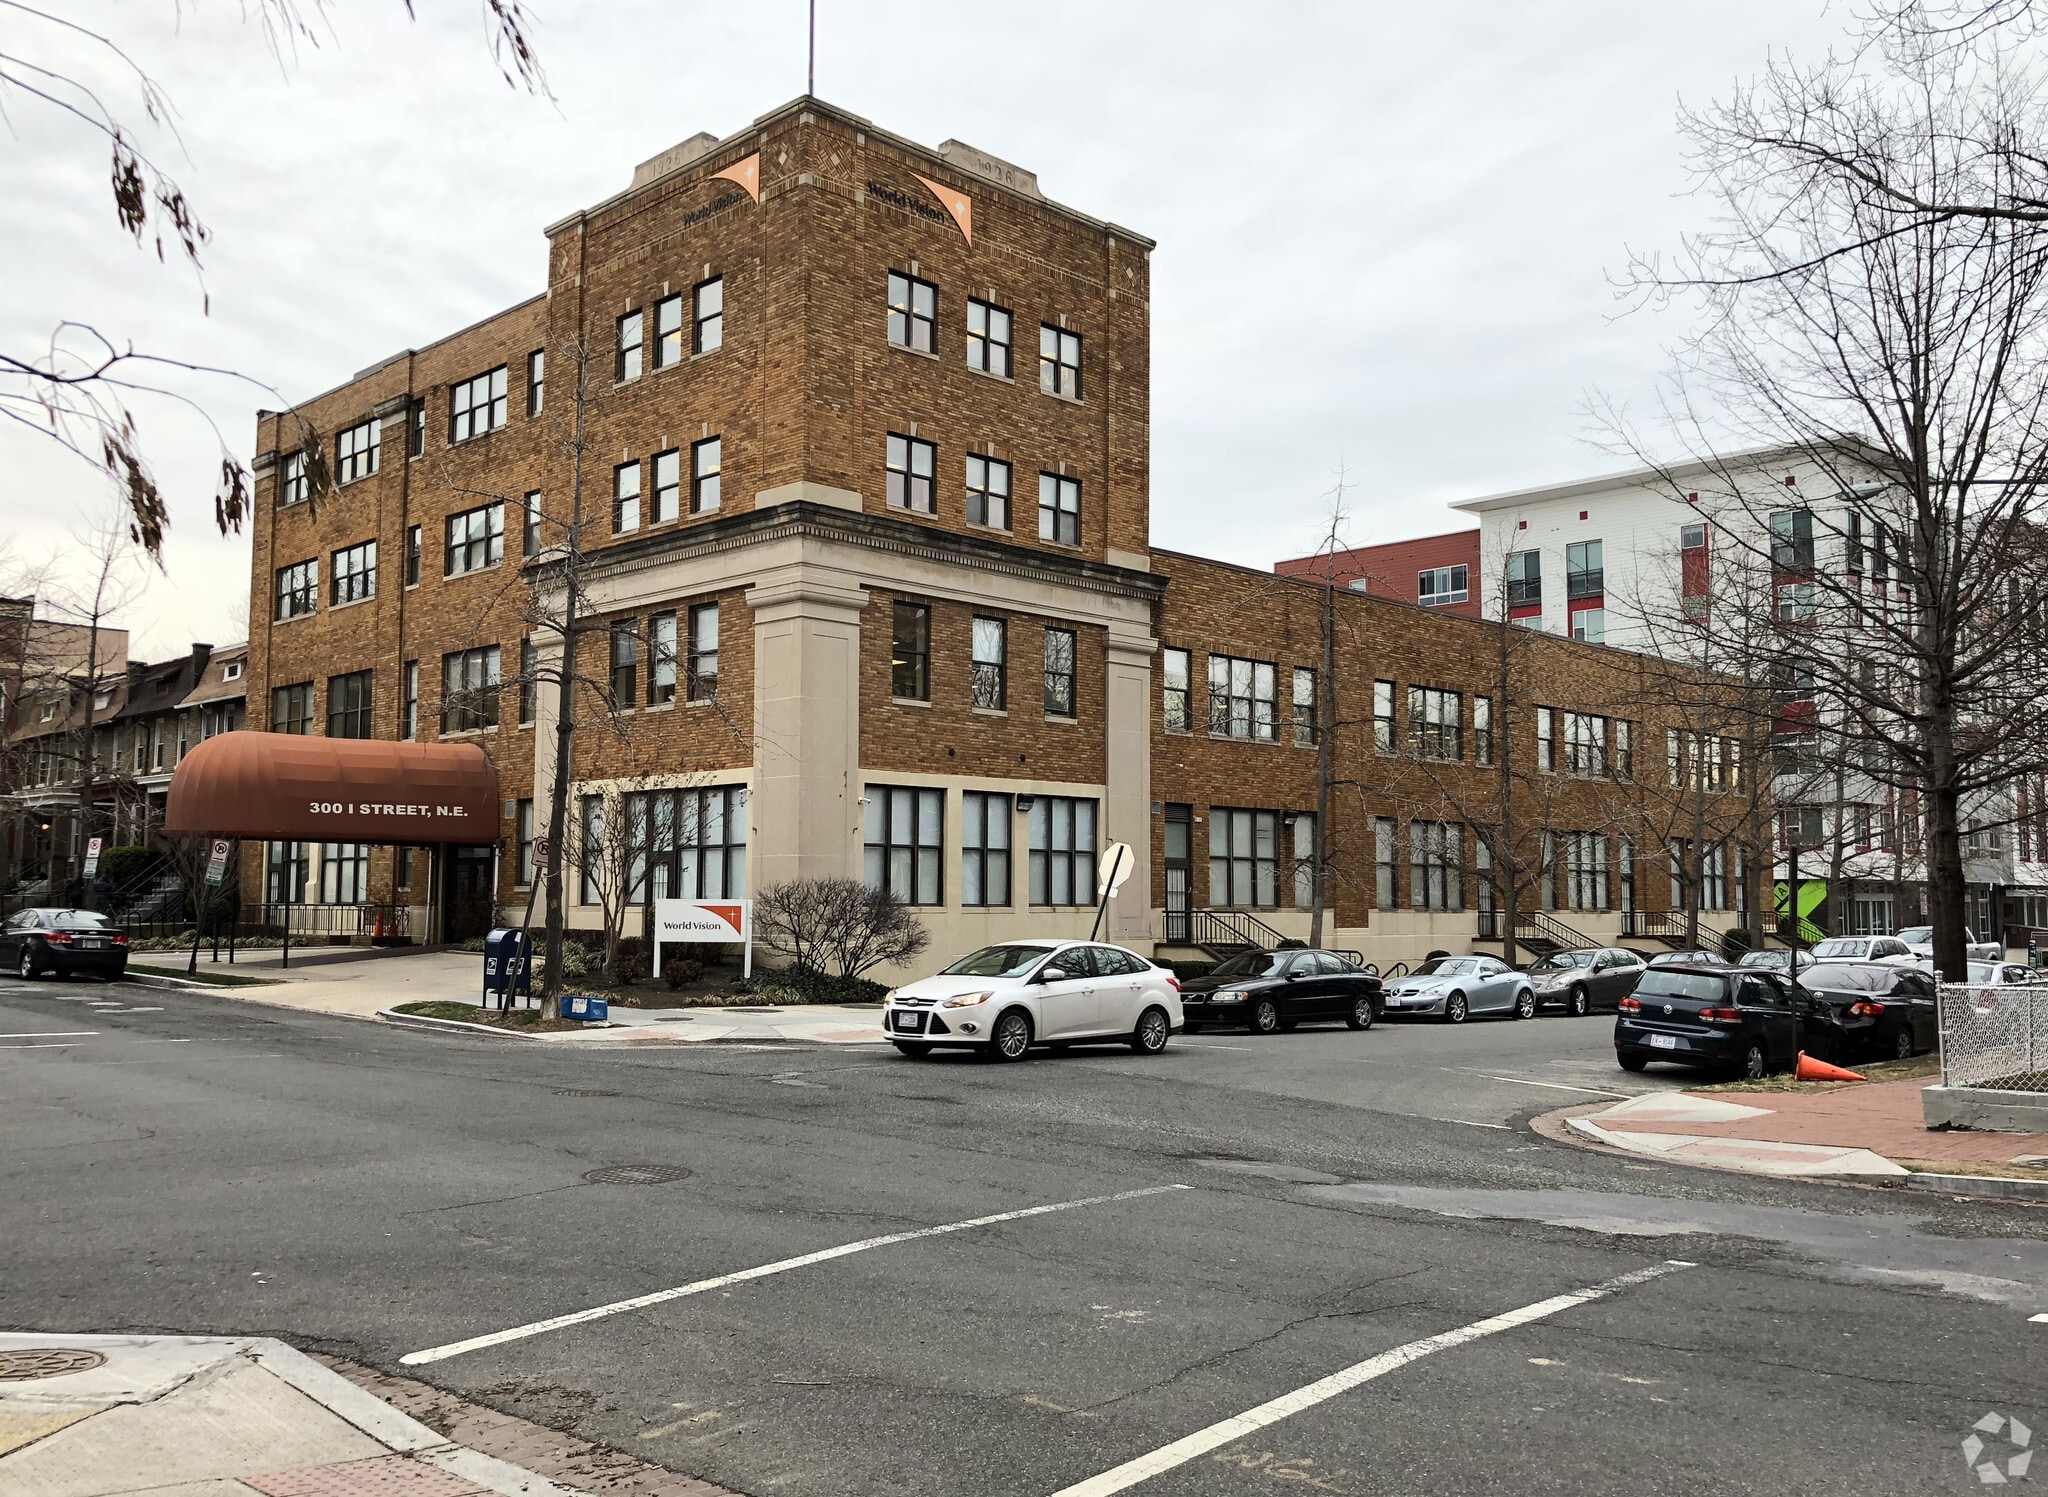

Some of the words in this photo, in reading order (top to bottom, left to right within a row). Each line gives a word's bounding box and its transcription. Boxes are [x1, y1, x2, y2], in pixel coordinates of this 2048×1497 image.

[652, 151, 681, 178] 1926
[977, 157, 1014, 185] 1926
[682, 200, 711, 230] World
[710, 192, 742, 213] Vision
[866, 180, 907, 209] World
[908, 197, 945, 223] Vision
[309, 802, 343, 814] 300
[348, 803, 354, 814] I
[359, 804, 432, 818] STREET,
[436, 805, 469, 817] N.E.
[663, 921, 692, 930] World
[692, 921, 721, 930] Vision
